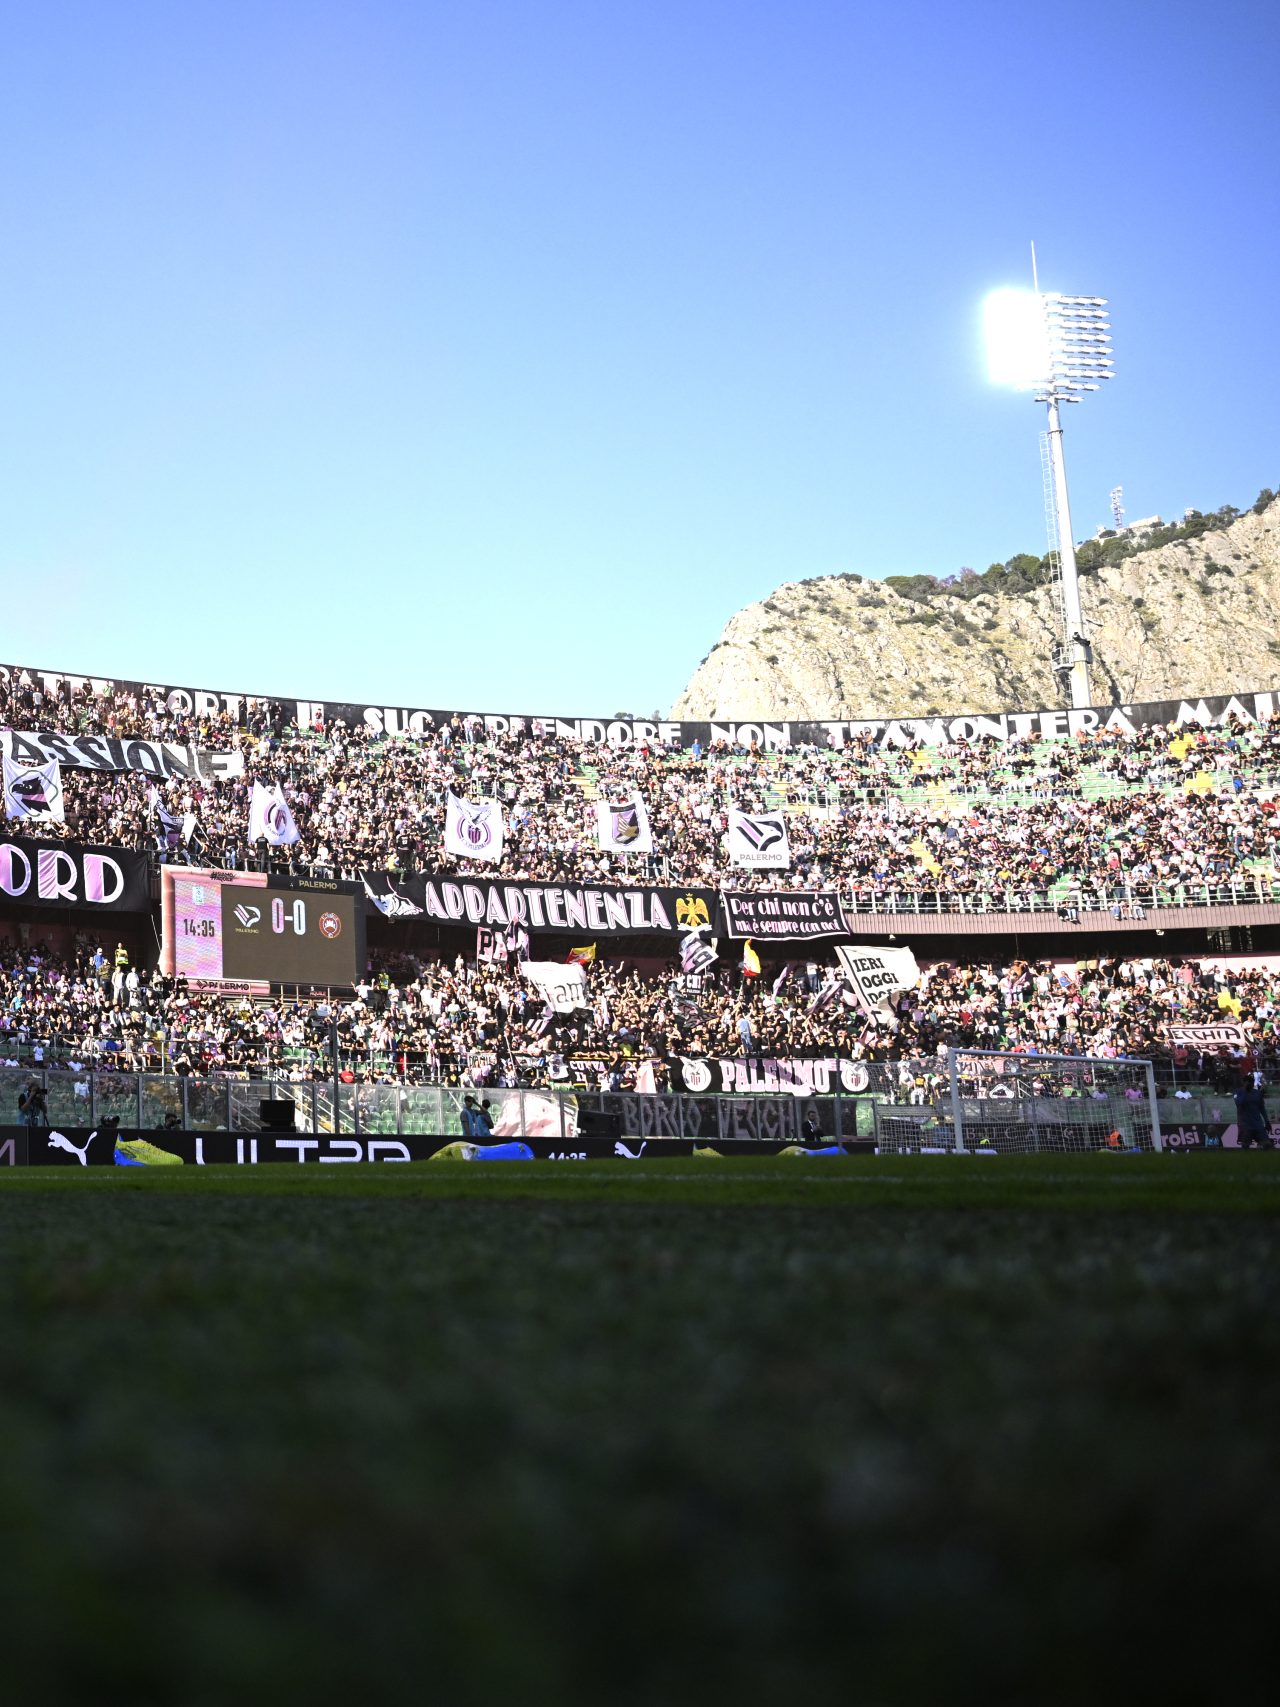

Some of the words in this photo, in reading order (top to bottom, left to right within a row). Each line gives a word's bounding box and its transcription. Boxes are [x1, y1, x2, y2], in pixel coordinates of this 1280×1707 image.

[710, 723, 791, 750] NON
[298, 880, 338, 890] PALERMO
[426, 880, 672, 930] APPARTENENZA
[730, 898, 755, 916] Per
[758, 897, 780, 917] chi
[782, 902, 810, 917] non
[183, 919, 215, 937] 14:35
[735, 919, 753, 932] ma
[752, 918, 761, 933] è
[760, 920, 799, 933] sempre
[799, 921, 821, 933] con
[820, 919, 841, 931] noi
[852, 957, 885, 972] IERI
[209, 981, 250, 991] PALERMO
[861, 972, 899, 989] OGGI
[719, 1058, 831, 1093] PALERMO
[719, 1097, 821, 1137] VECCHA
